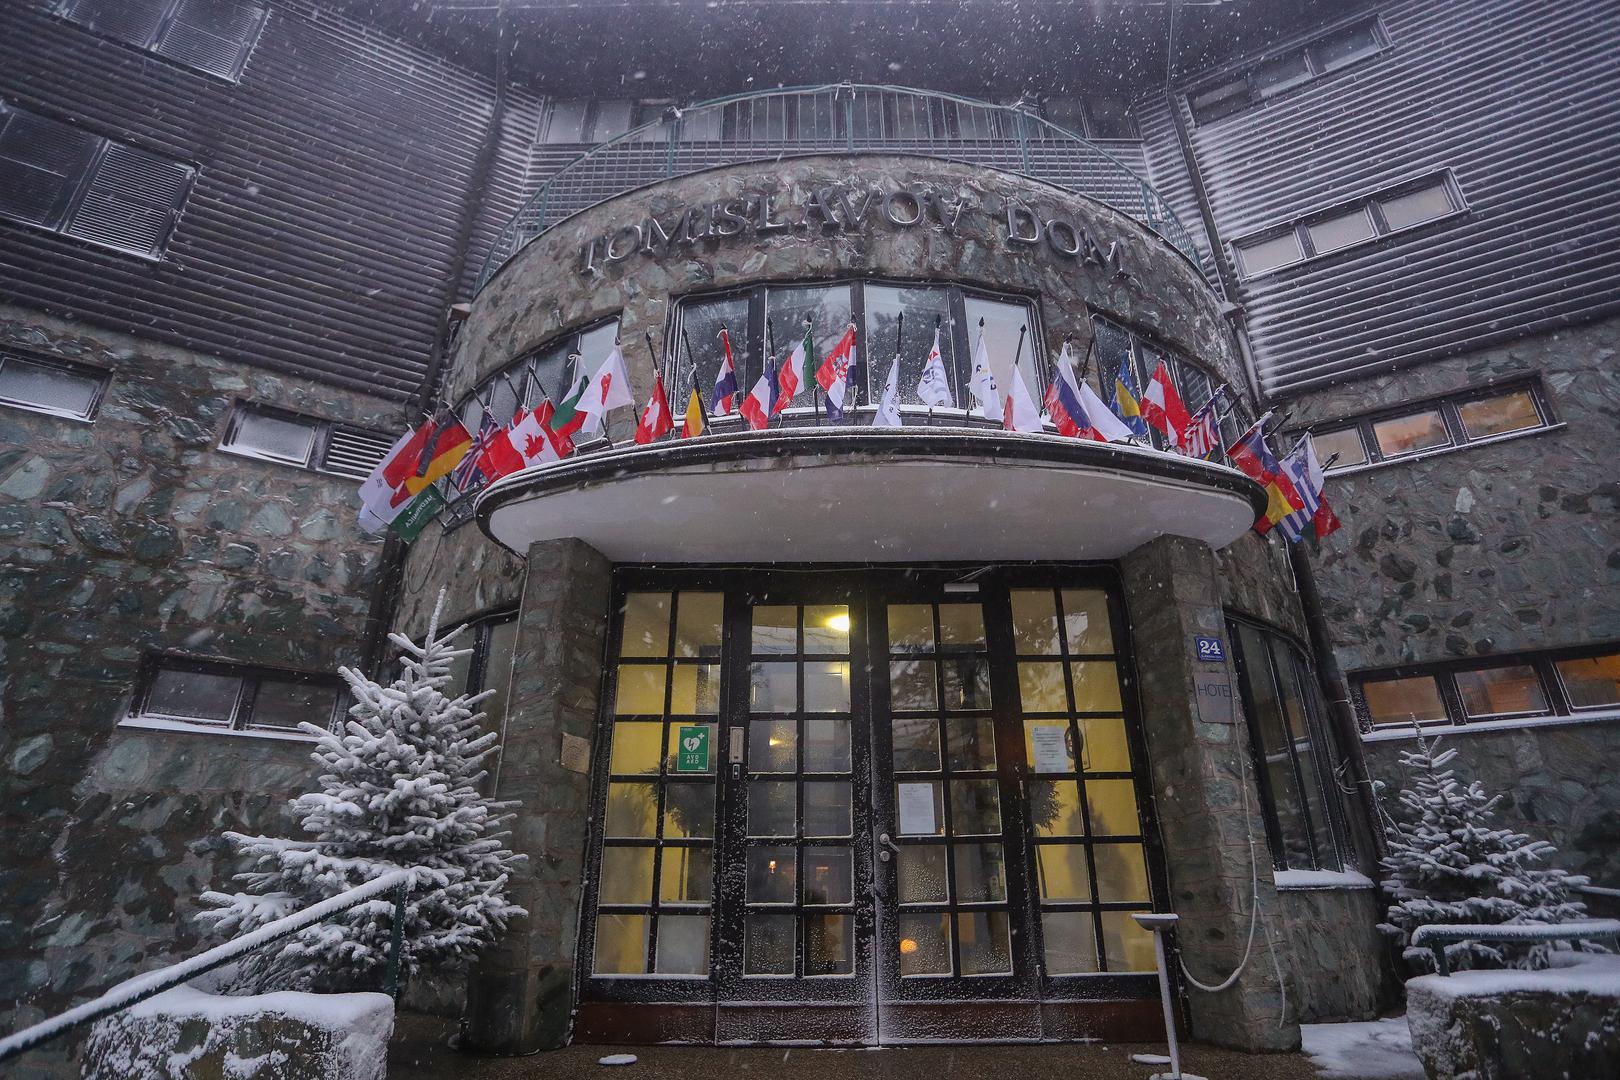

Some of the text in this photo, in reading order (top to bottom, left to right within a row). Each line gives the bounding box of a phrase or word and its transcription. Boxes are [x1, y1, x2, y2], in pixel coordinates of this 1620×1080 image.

[579, 182, 1131, 279] TOMISLAVOV DOM
[1199, 640, 1221, 655] 24
